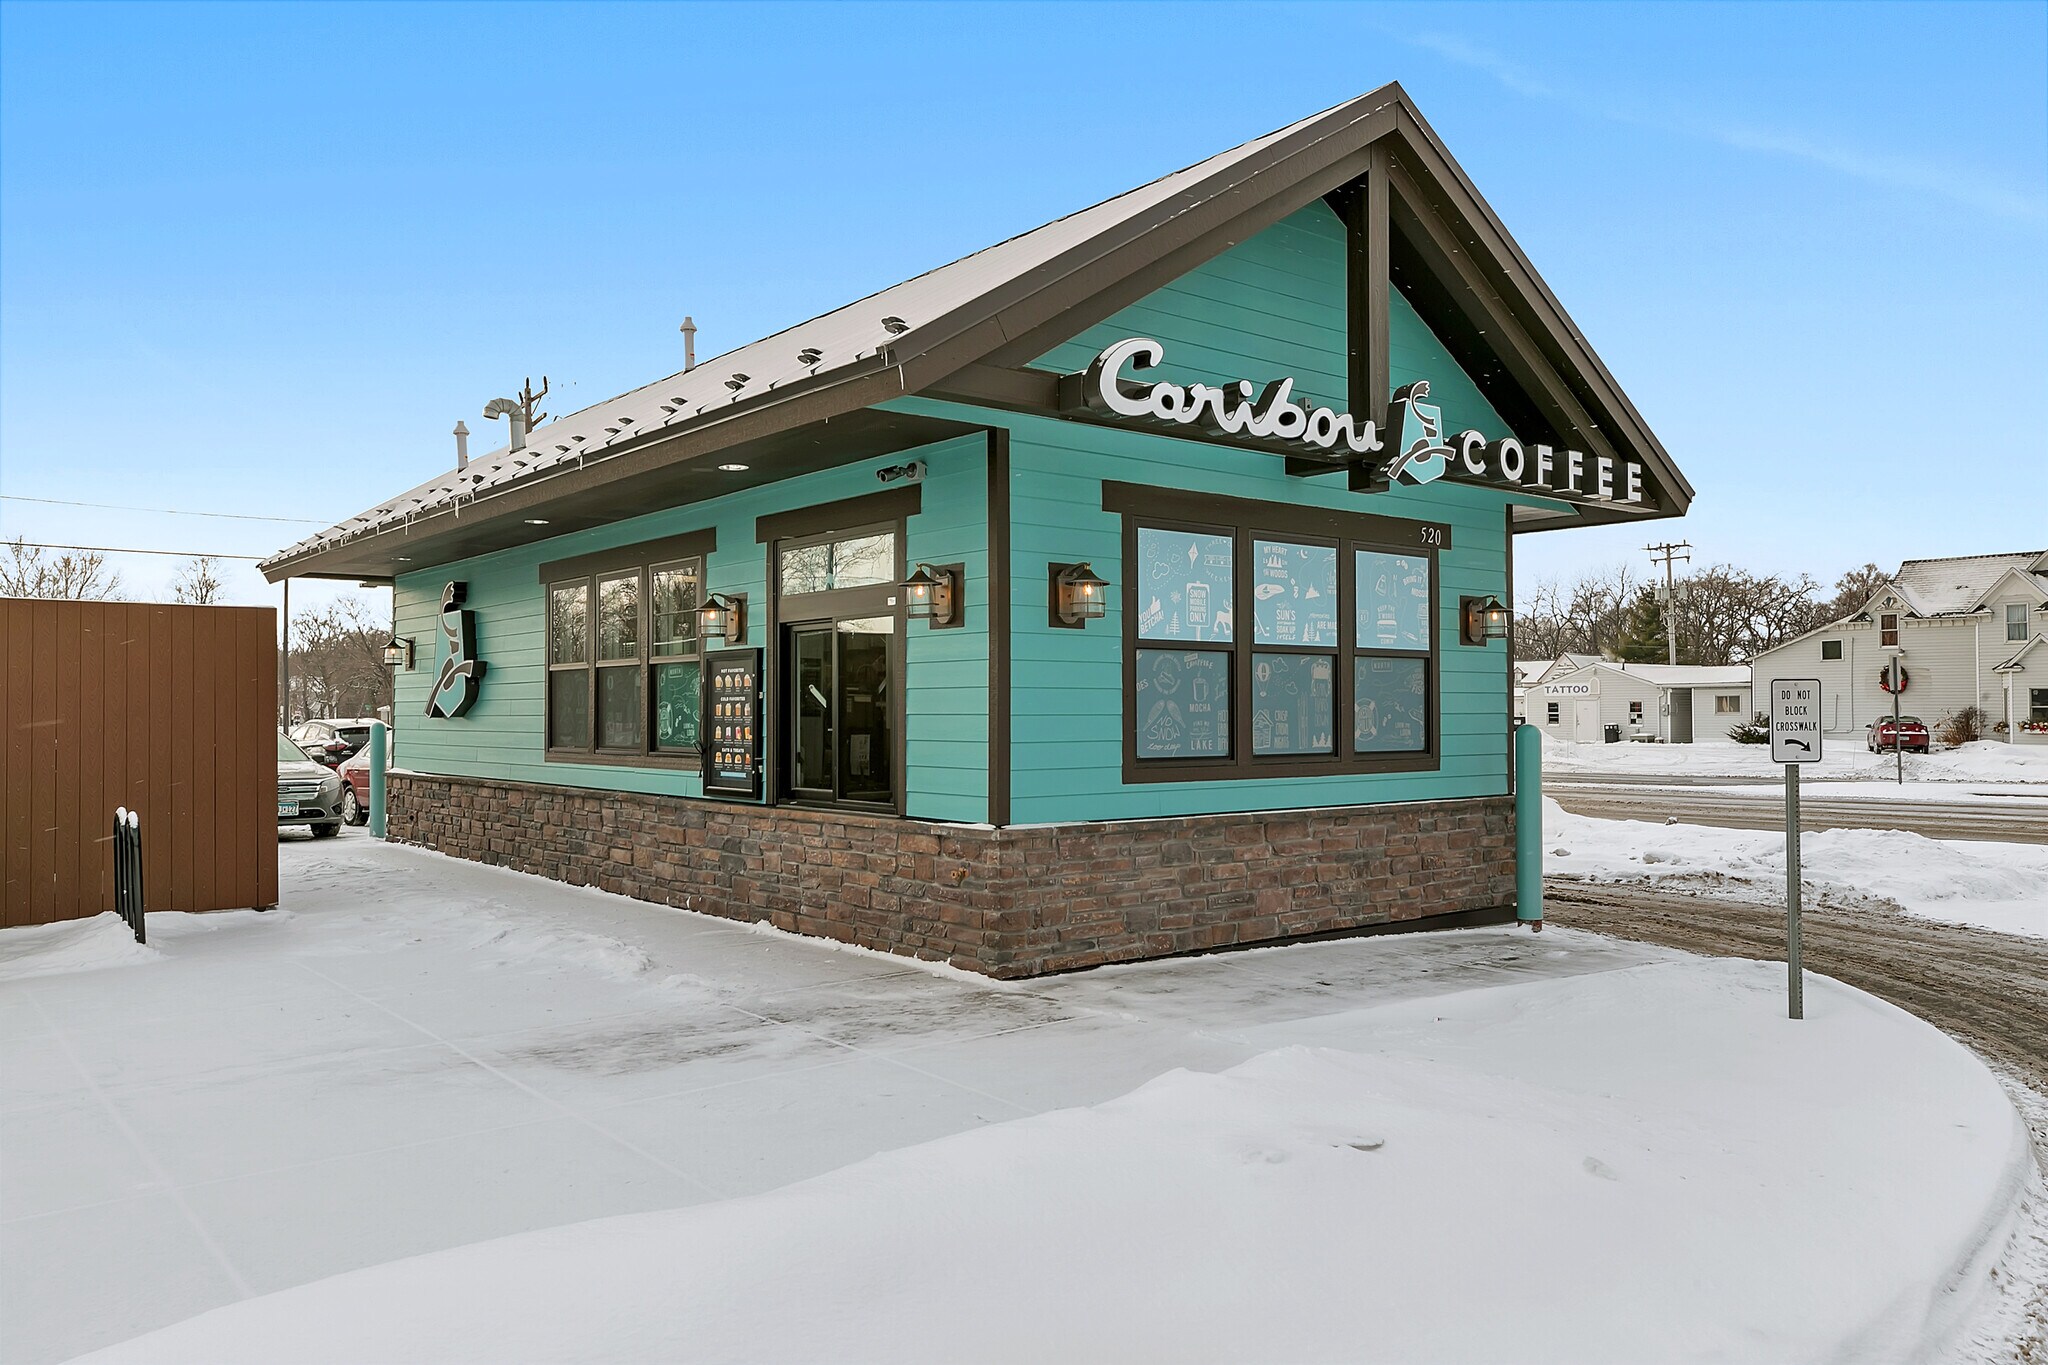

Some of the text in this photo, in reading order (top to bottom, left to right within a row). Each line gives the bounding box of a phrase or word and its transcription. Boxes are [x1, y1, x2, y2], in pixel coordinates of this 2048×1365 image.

[1099, 337, 1642, 502] Caribou COFFEE
[1421, 526, 1441, 546] 520
[1272, 546, 1288, 556] HEART
[1270, 569, 1289, 579] WOODS
[1189, 589, 1207, 599] SNOW
[1139, 607, 1153, 624] YOU
[1189, 612, 1207, 623] ONLY
[1276, 610, 1297, 621] SUN'S
[1140, 610, 1165, 635] BETCHA!
[1544, 685, 1589, 694] TATTOO
[1782, 690, 1811, 700] DO NOT
[1189, 703, 1212, 713] MOCHA
[1785, 706, 1808, 716] BLOCK
[1776, 722, 1818, 732] CROSSWALK
[1190, 739, 1213, 751] LAKE
